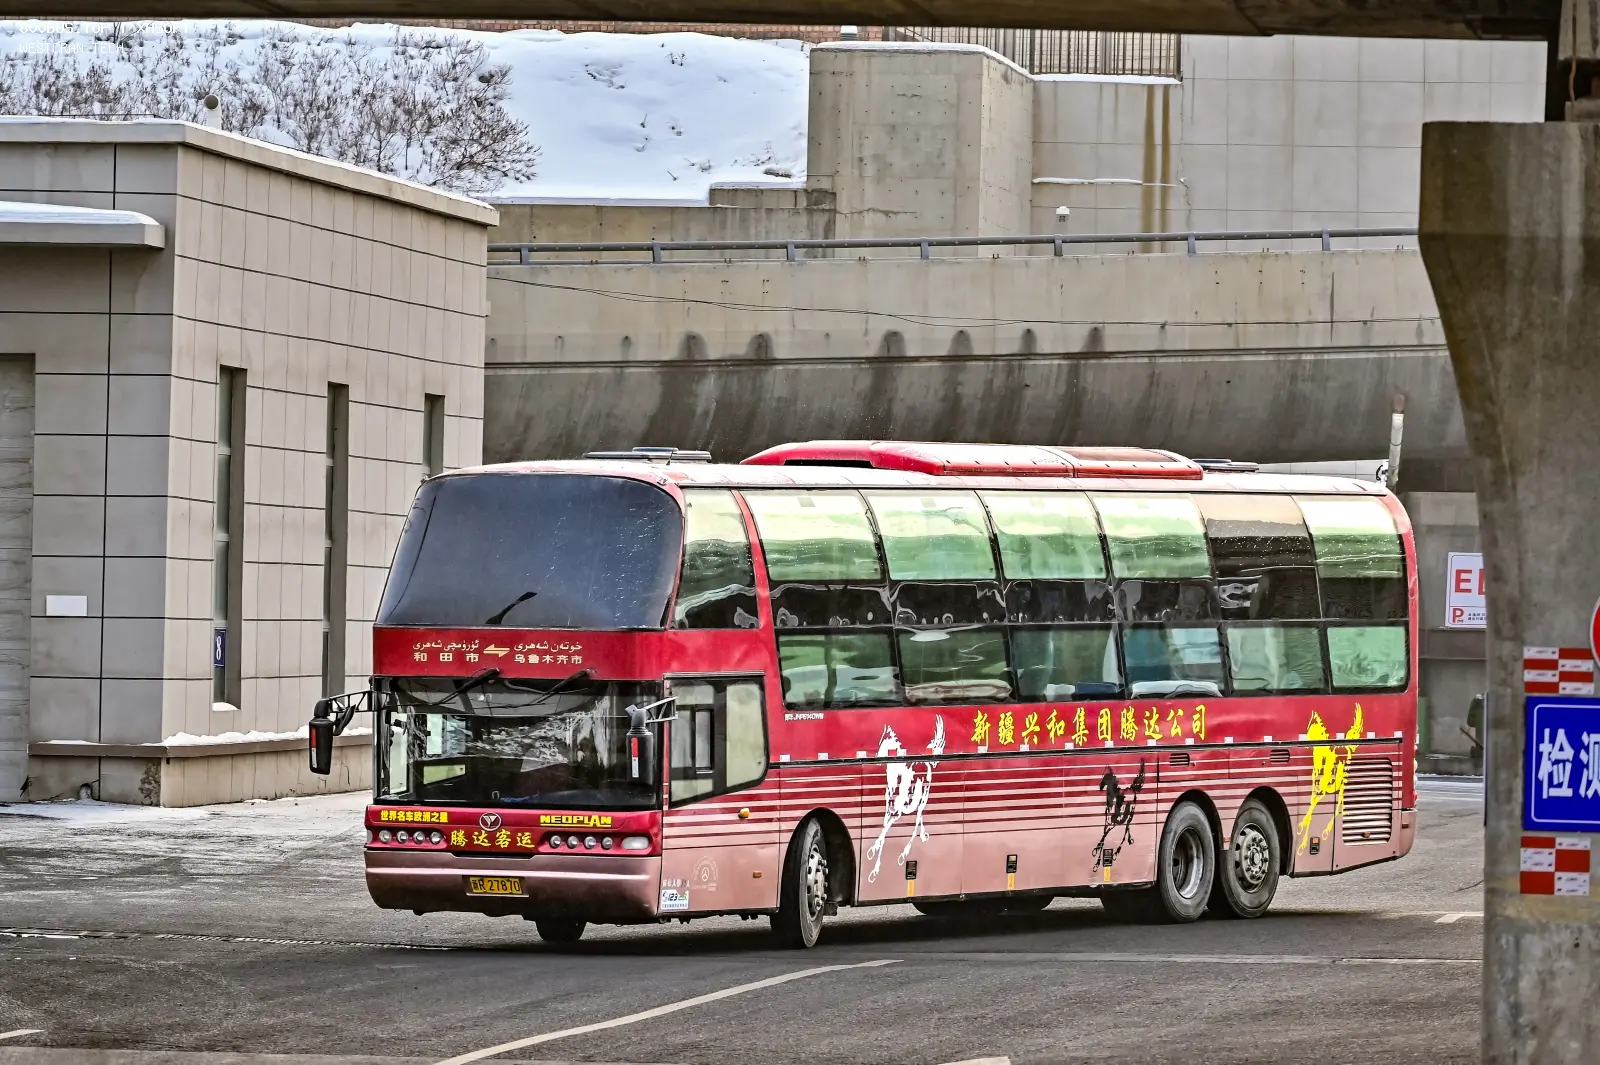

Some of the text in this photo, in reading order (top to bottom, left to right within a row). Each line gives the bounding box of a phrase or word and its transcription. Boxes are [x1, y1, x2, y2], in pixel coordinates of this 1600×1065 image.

[413, 651, 480, 663] 和田市
[513, 653, 583, 665] 乌鲁木齐市
[970, 704, 1207, 749] 新疆兴和集团腾达公司
[380, 810, 448, 823] 世界名车欧洲之星
[539, 814, 612, 828] NEOPLAN
[450, 829, 536, 849] 腾达客运
